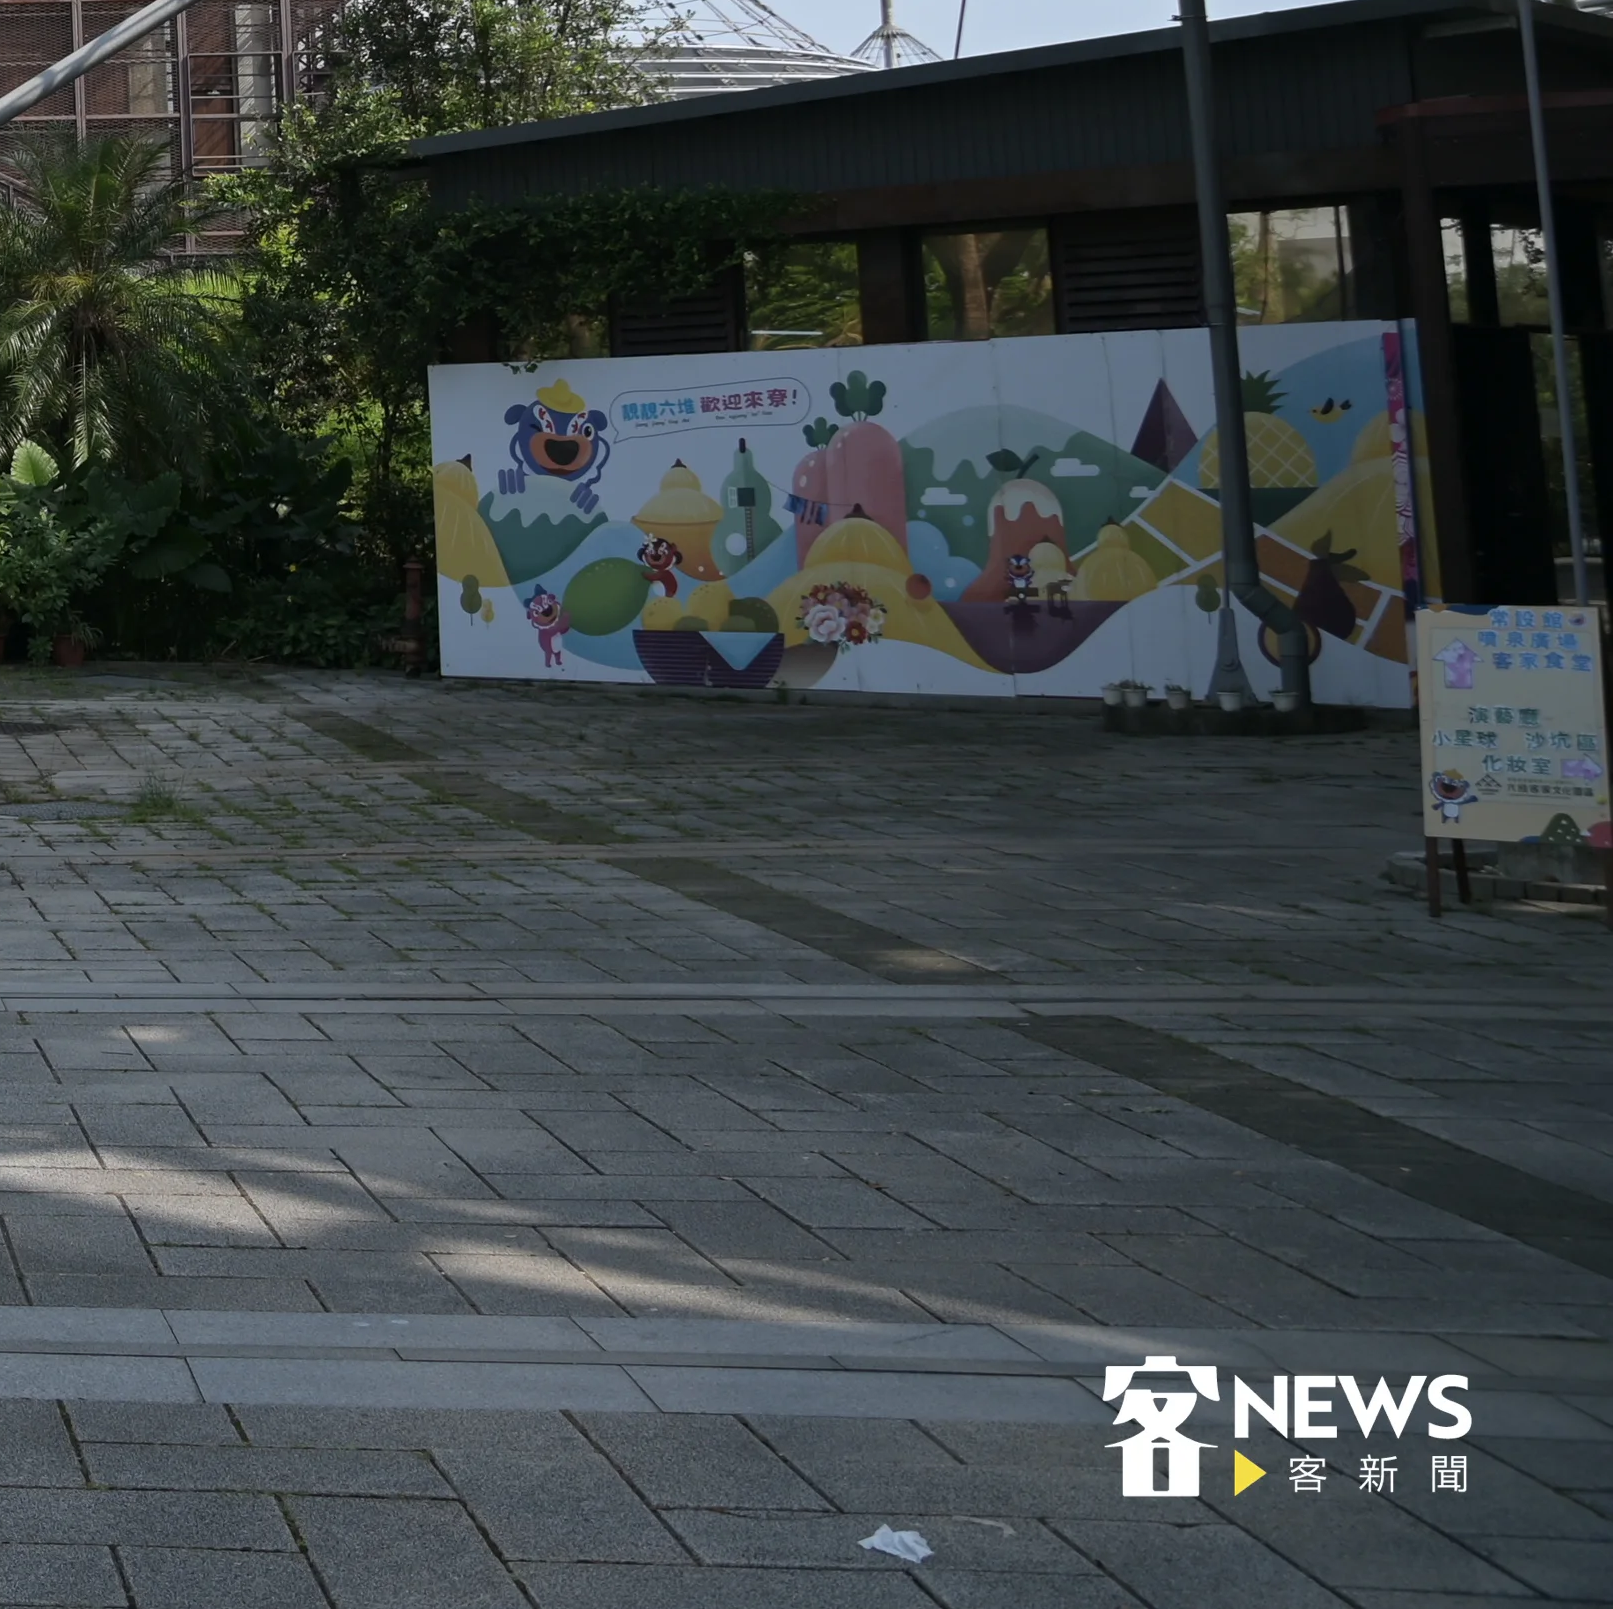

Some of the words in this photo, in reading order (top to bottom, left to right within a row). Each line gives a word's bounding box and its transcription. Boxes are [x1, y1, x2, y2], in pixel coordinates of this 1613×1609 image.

[1490, 611, 1564, 629] 常設館
[1478, 631, 1579, 650] 噴泉廣場
[1492, 652, 1592, 672] 客家食堂
[1433, 730, 1499, 749] 小星球
[1525, 731, 1598, 752] 沙坑區
